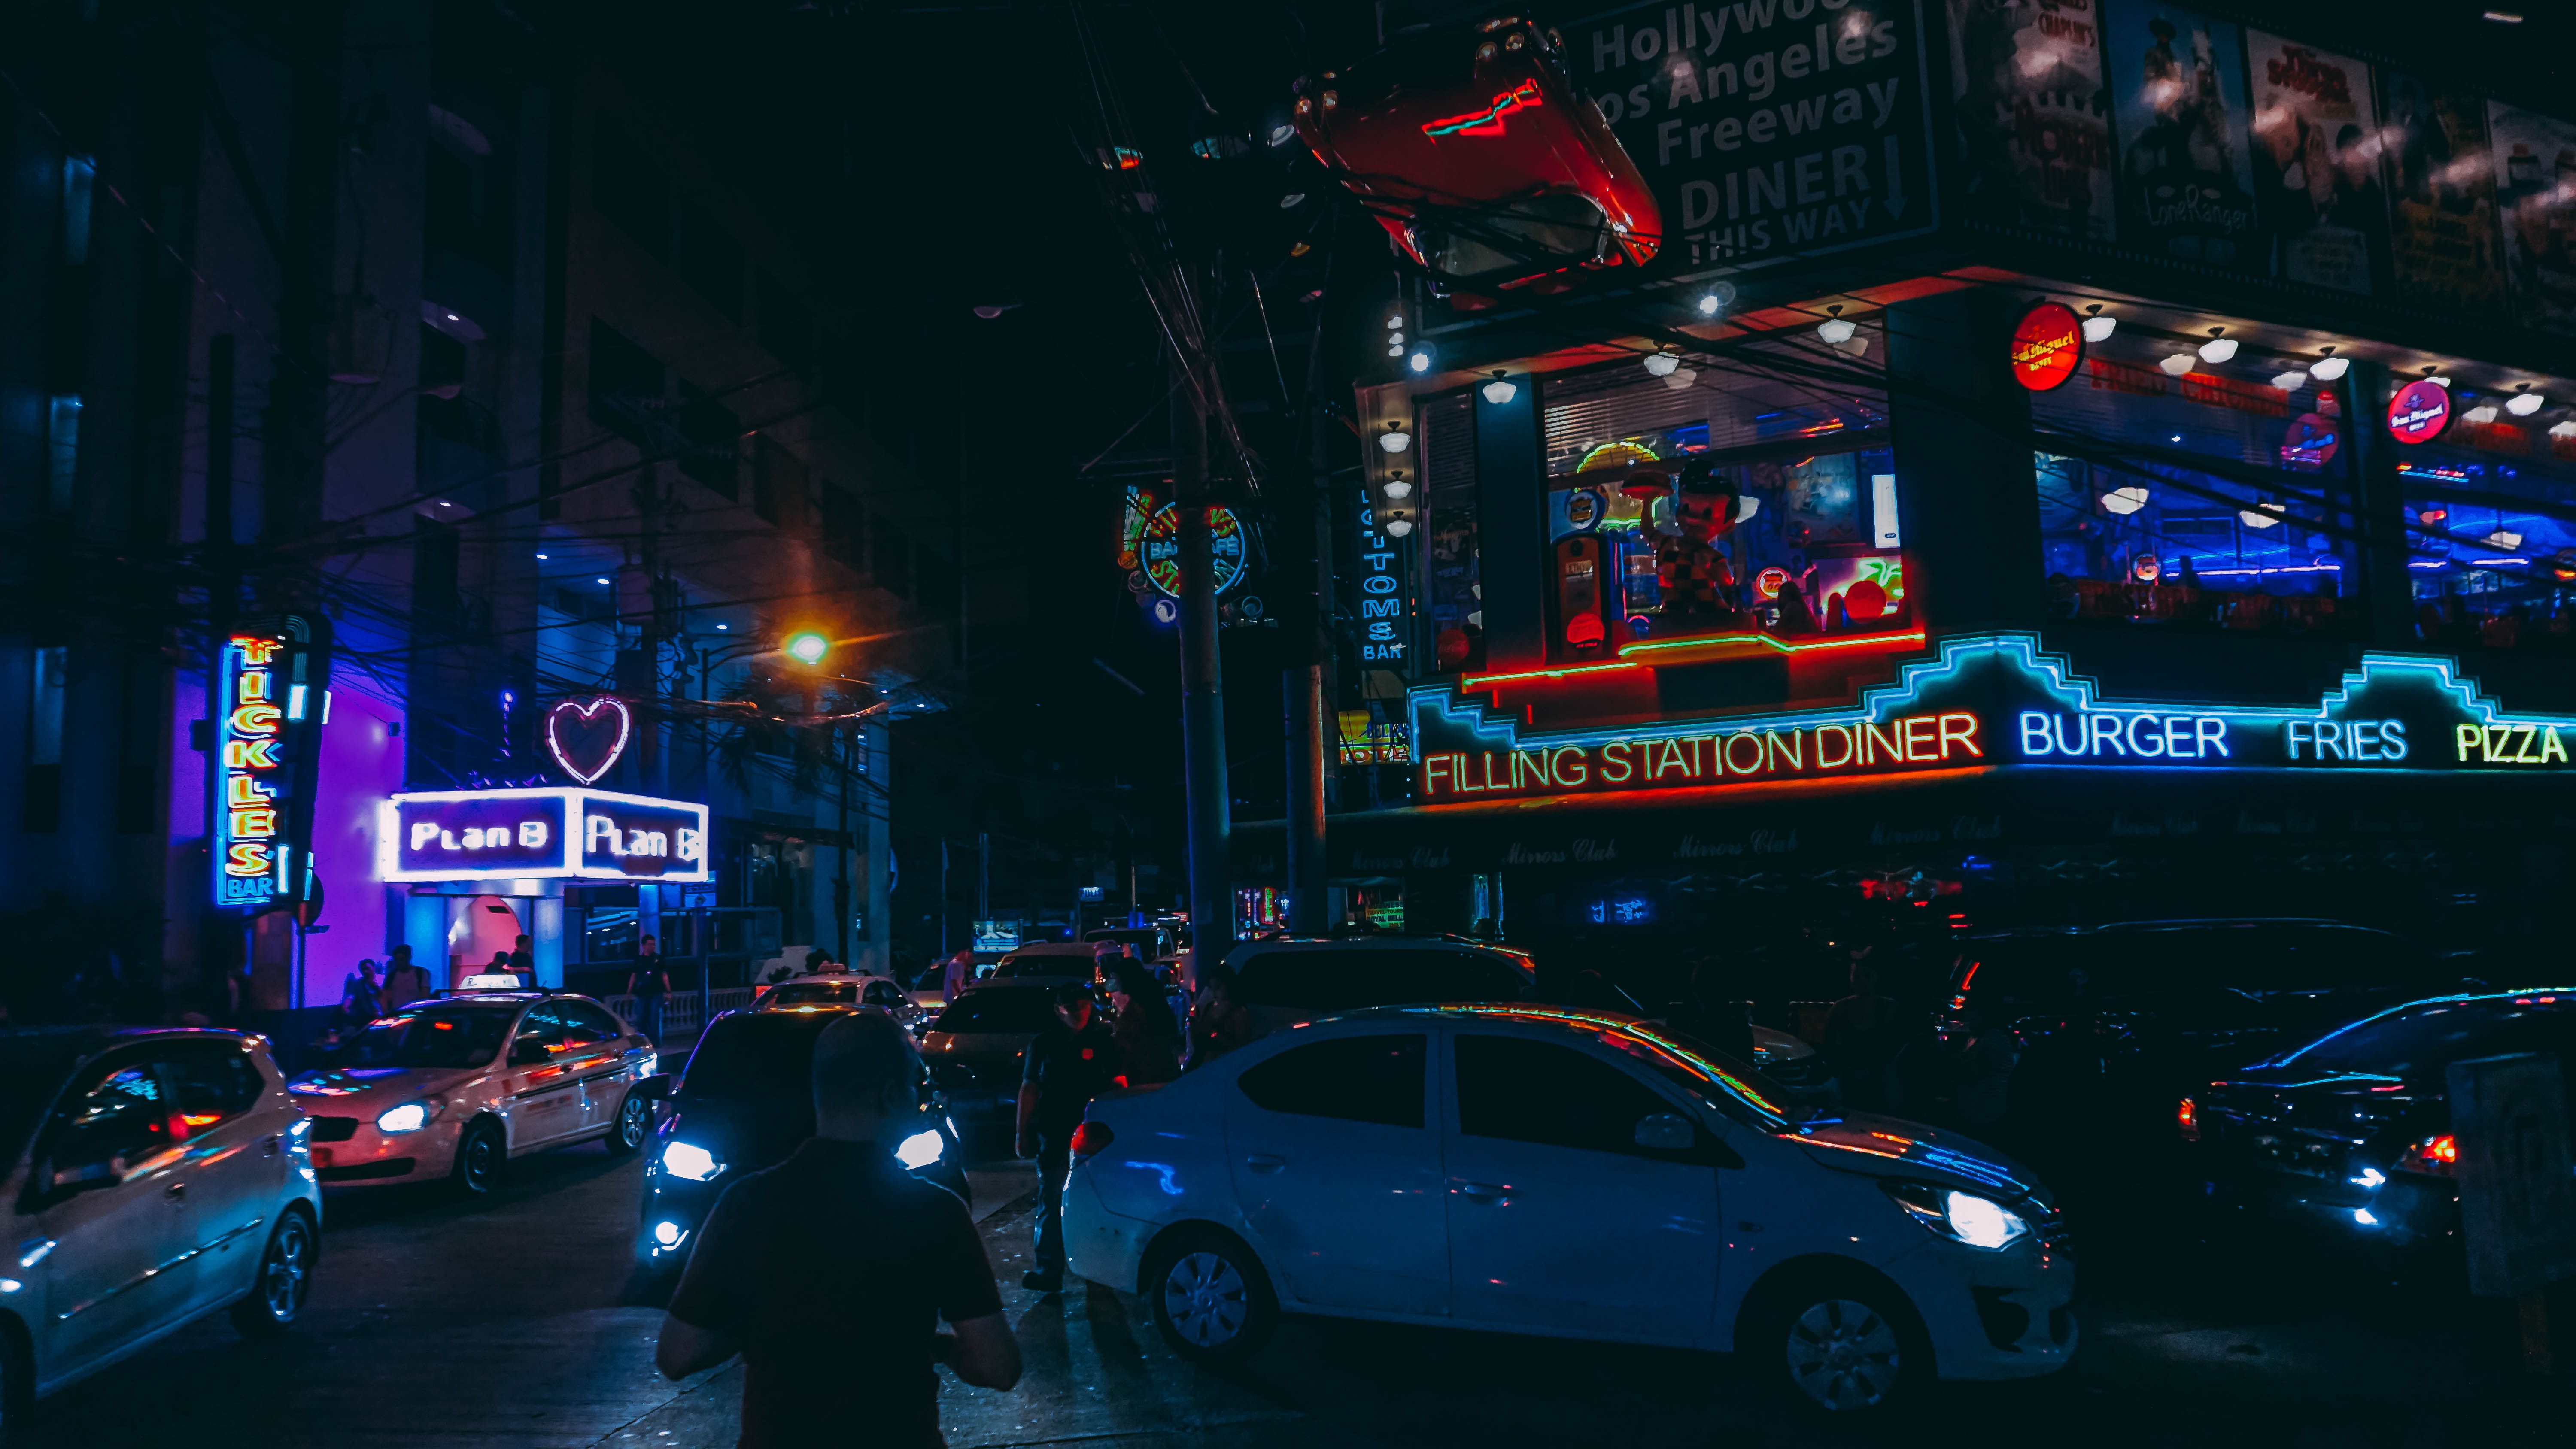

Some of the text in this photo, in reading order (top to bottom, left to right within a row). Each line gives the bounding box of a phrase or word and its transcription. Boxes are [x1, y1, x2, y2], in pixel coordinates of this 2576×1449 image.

[1571, 19, 1898, 125] os Angeles
[1657, 77, 1899, 166] Freeway
[1680, 145, 1871, 230] DINER
[1685, 196, 1872, 264] THIS WAY
[1364, 644, 1401, 660] BAR
[225, 636, 285, 878] TICKLES
[1425, 710, 2569, 795] FILLING STATION DINER BURGER FRIES PIZZA
[518, 821, 548, 848] B
[677, 827, 701, 862] B
[1572, 838, 1619, 862] Club
[1750, 827, 1800, 854] Club
[227, 878, 275, 899] BAR
